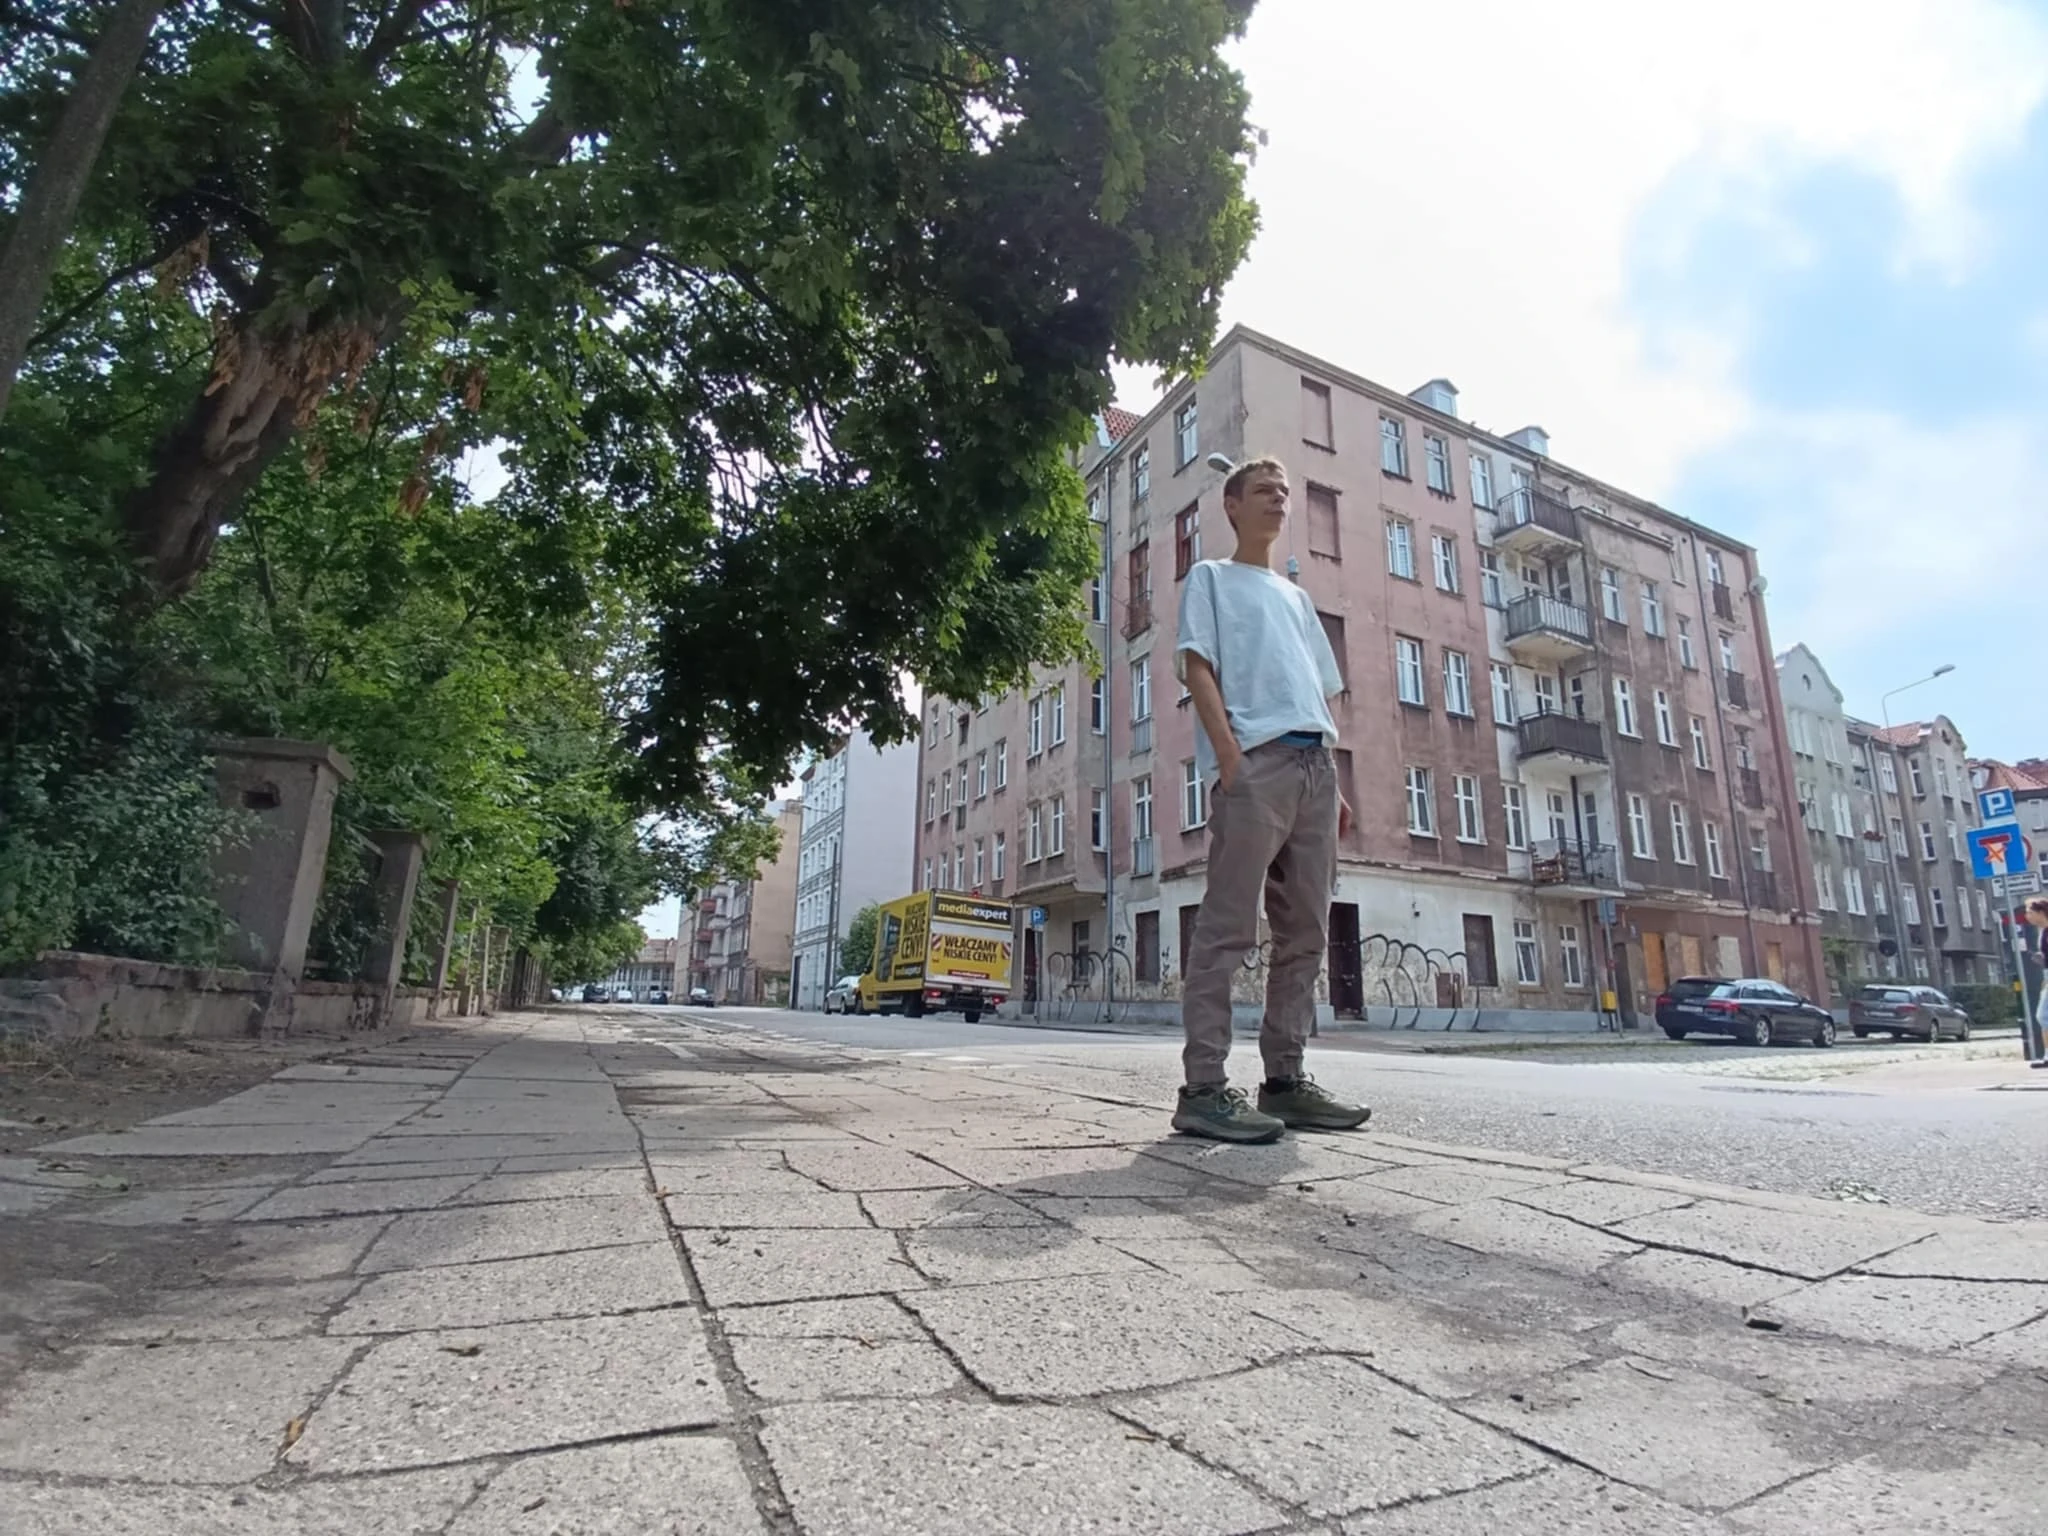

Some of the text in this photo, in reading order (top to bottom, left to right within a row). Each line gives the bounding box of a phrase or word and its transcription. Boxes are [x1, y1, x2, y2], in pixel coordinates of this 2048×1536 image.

[1985, 792, 2007, 816] P
[938, 903, 1008, 921] mediaexpert
[944, 948, 971, 961] NISKIE
